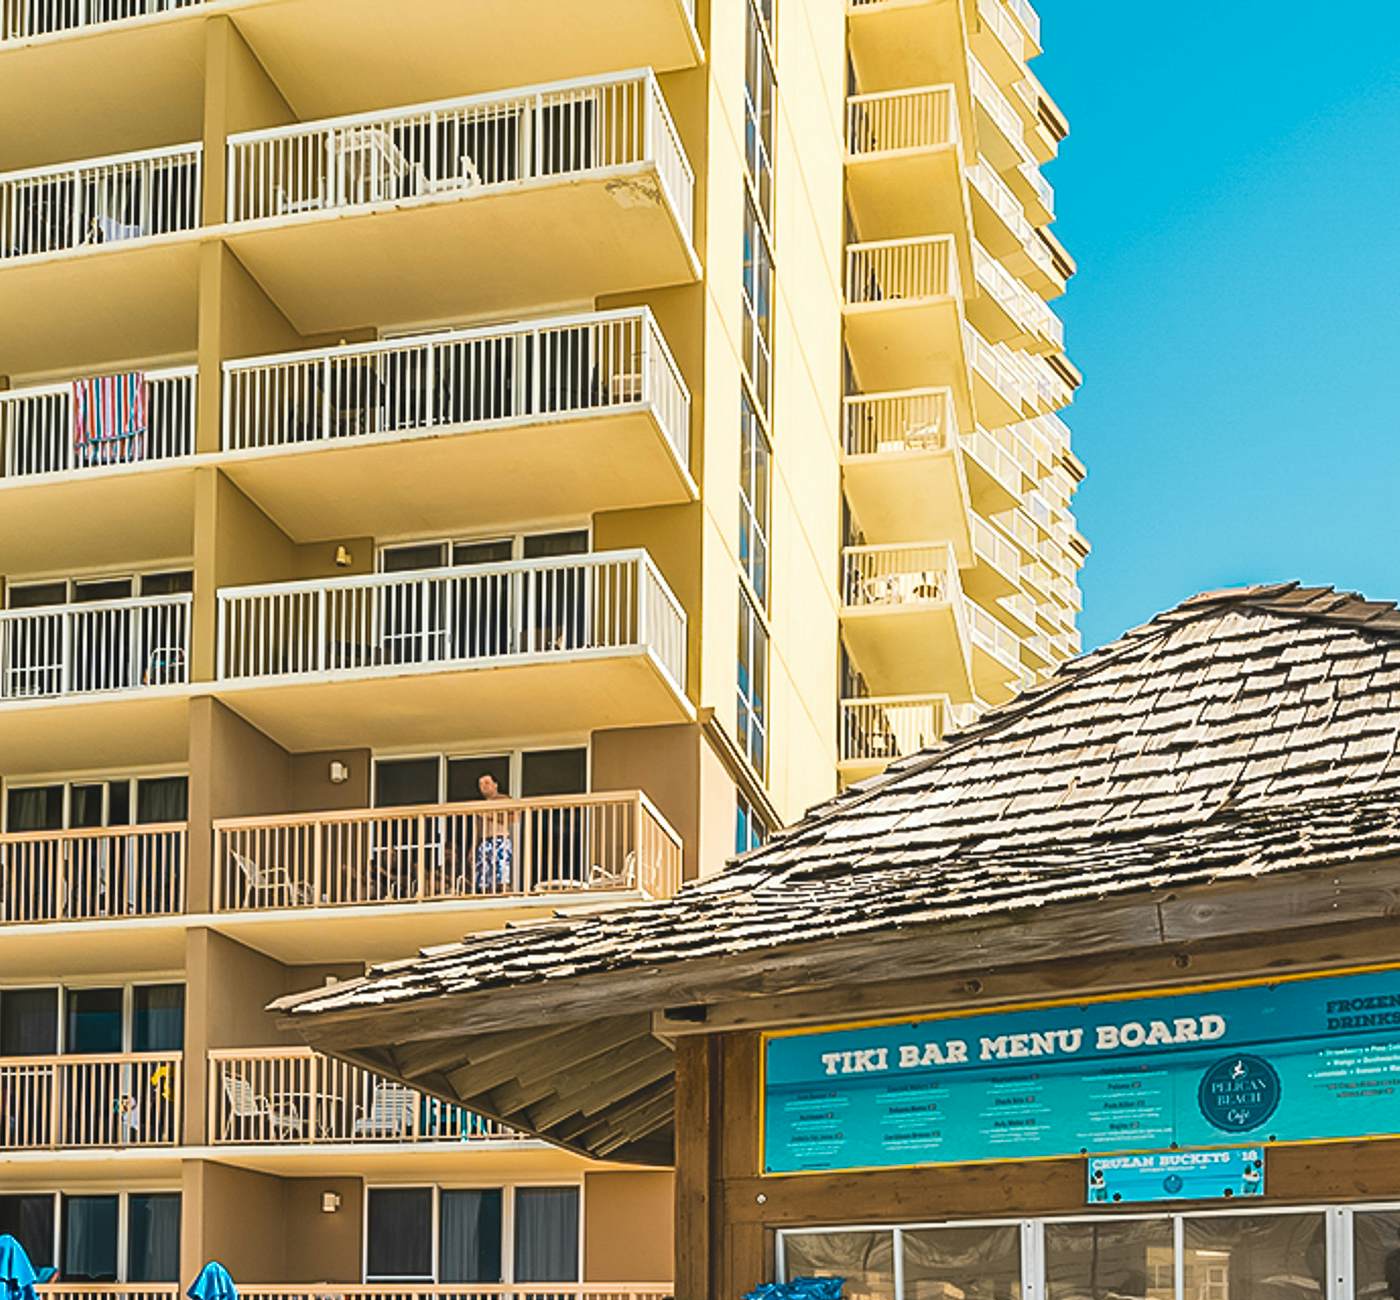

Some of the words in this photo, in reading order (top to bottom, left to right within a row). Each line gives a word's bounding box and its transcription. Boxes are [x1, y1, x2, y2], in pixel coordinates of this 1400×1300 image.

[1327, 1012, 1400, 1031] DRINKS
[822, 1048, 888, 1075] TIKI
[899, 1040, 968, 1068] BAR
[979, 1028, 1083, 1061] MENU
[1096, 1014, 1226, 1050] BOARD
[1211, 1078, 1266, 1094] PELICAN
[1217, 1092, 1261, 1106] BEACH
[1092, 1156, 1154, 1170] CRUZAN
[1159, 1152, 1231, 1166] BUCKETS
